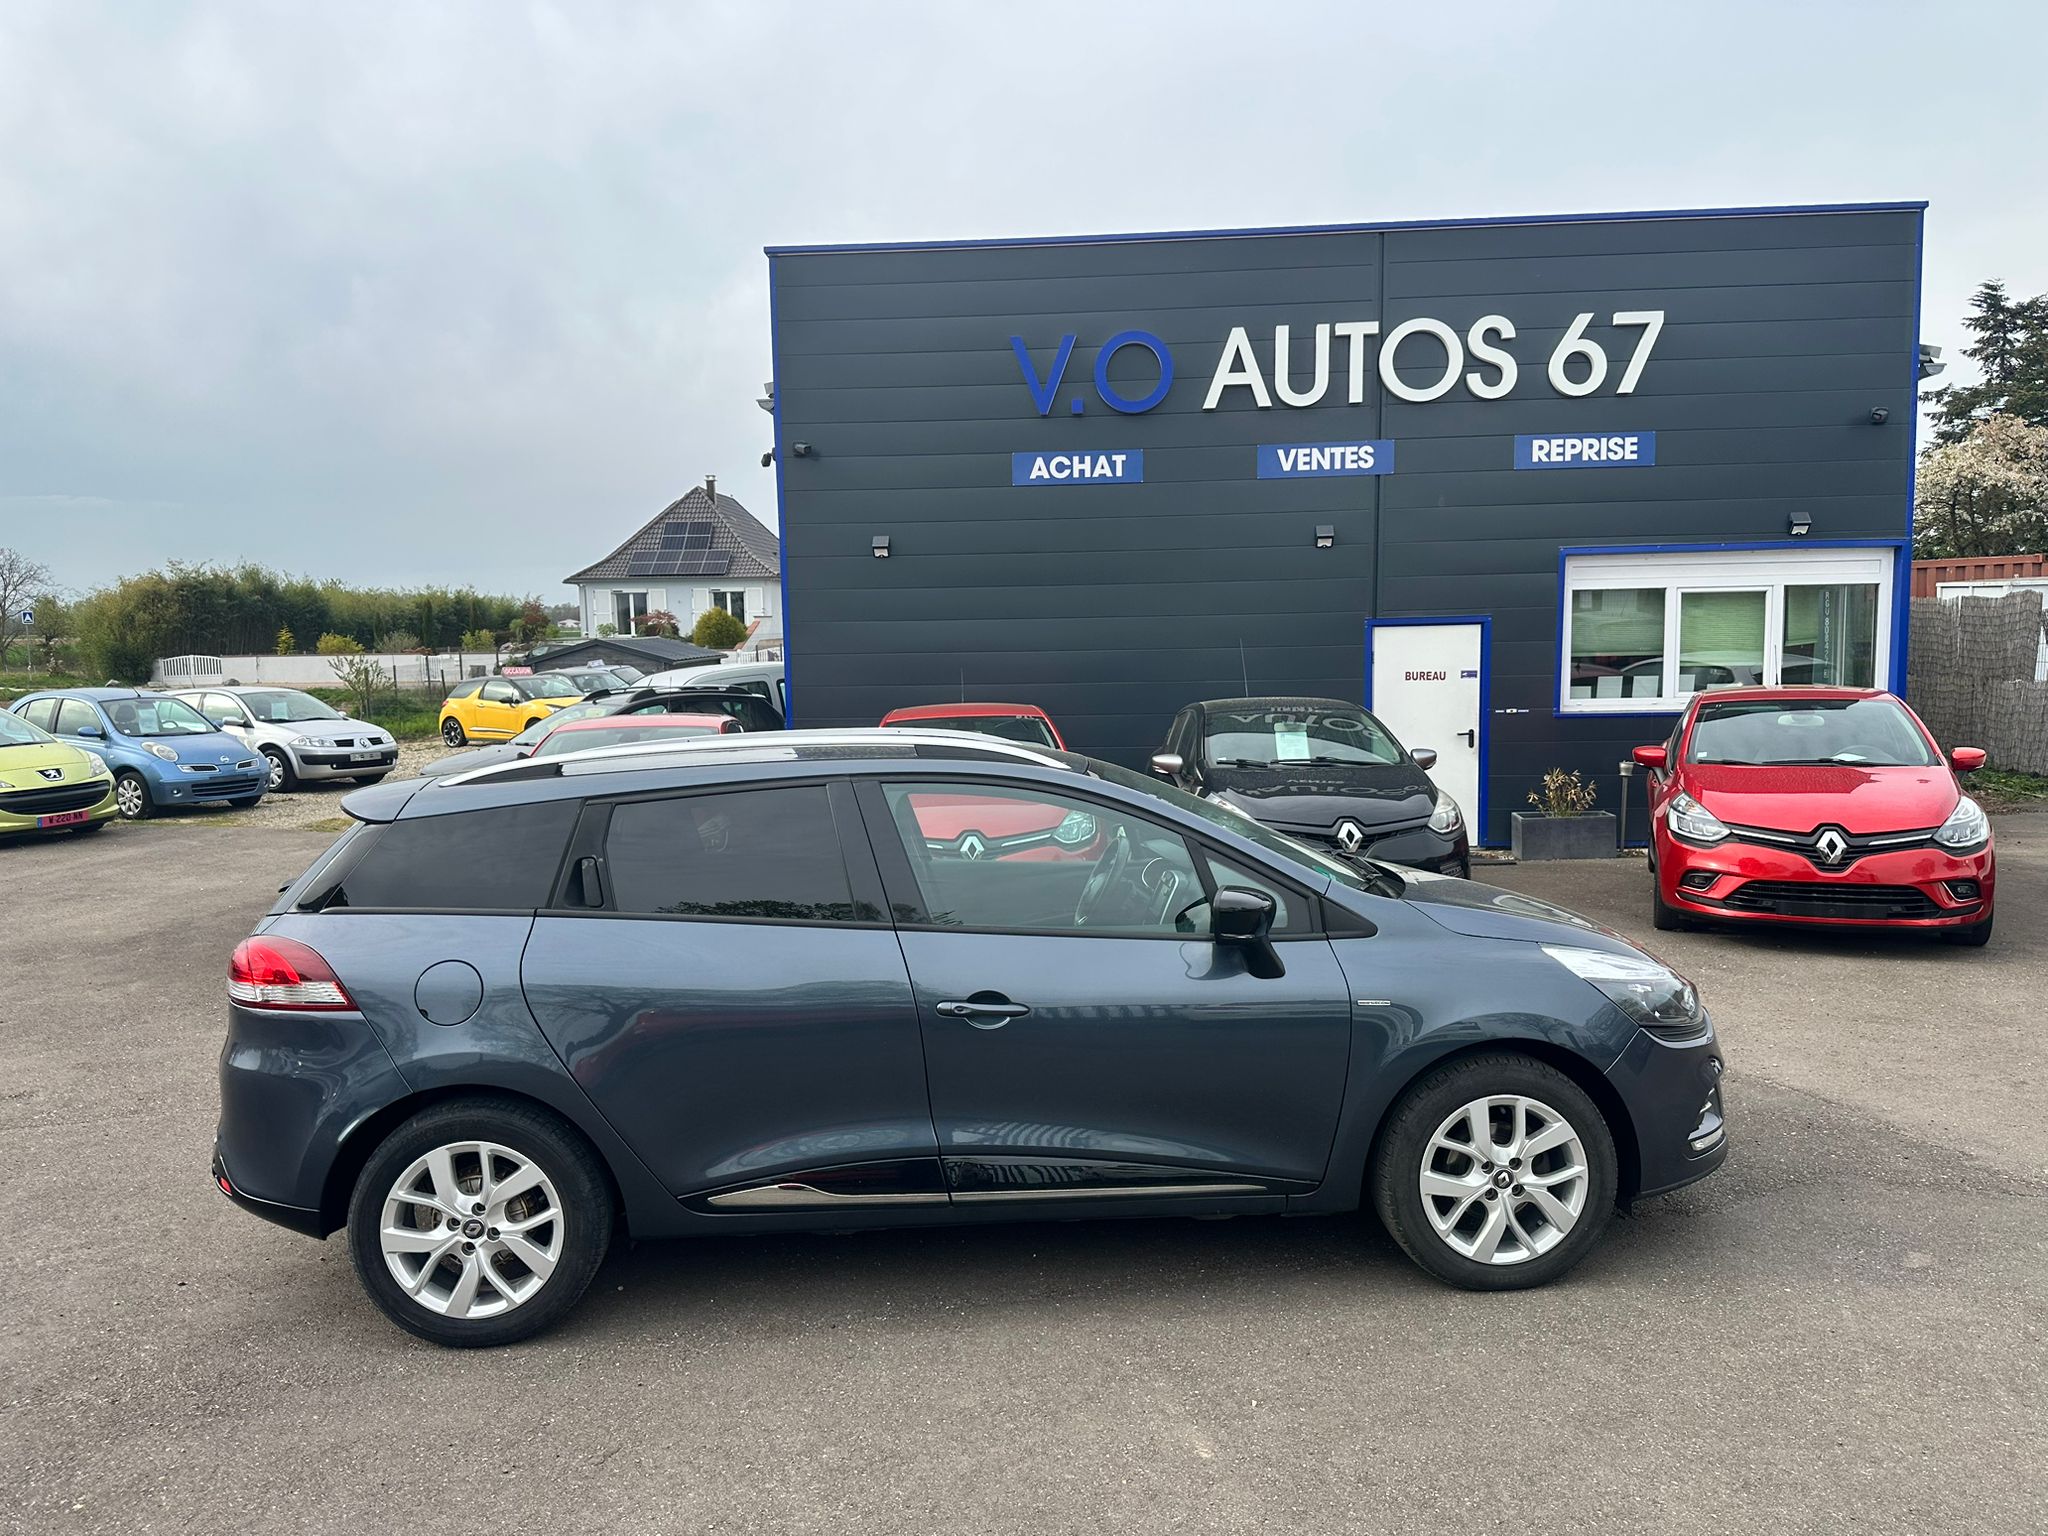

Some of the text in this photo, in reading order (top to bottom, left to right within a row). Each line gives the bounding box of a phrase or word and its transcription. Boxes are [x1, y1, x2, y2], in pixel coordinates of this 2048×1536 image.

[1011, 310, 1666, 416] V.O AUTOS 67
[1277, 445, 1375, 472] VENTES
[1531, 436, 1638, 463] REPRISE
[1029, 455, 1127, 480] ACHAT
[1404, 671, 1447, 681] BUREAU
